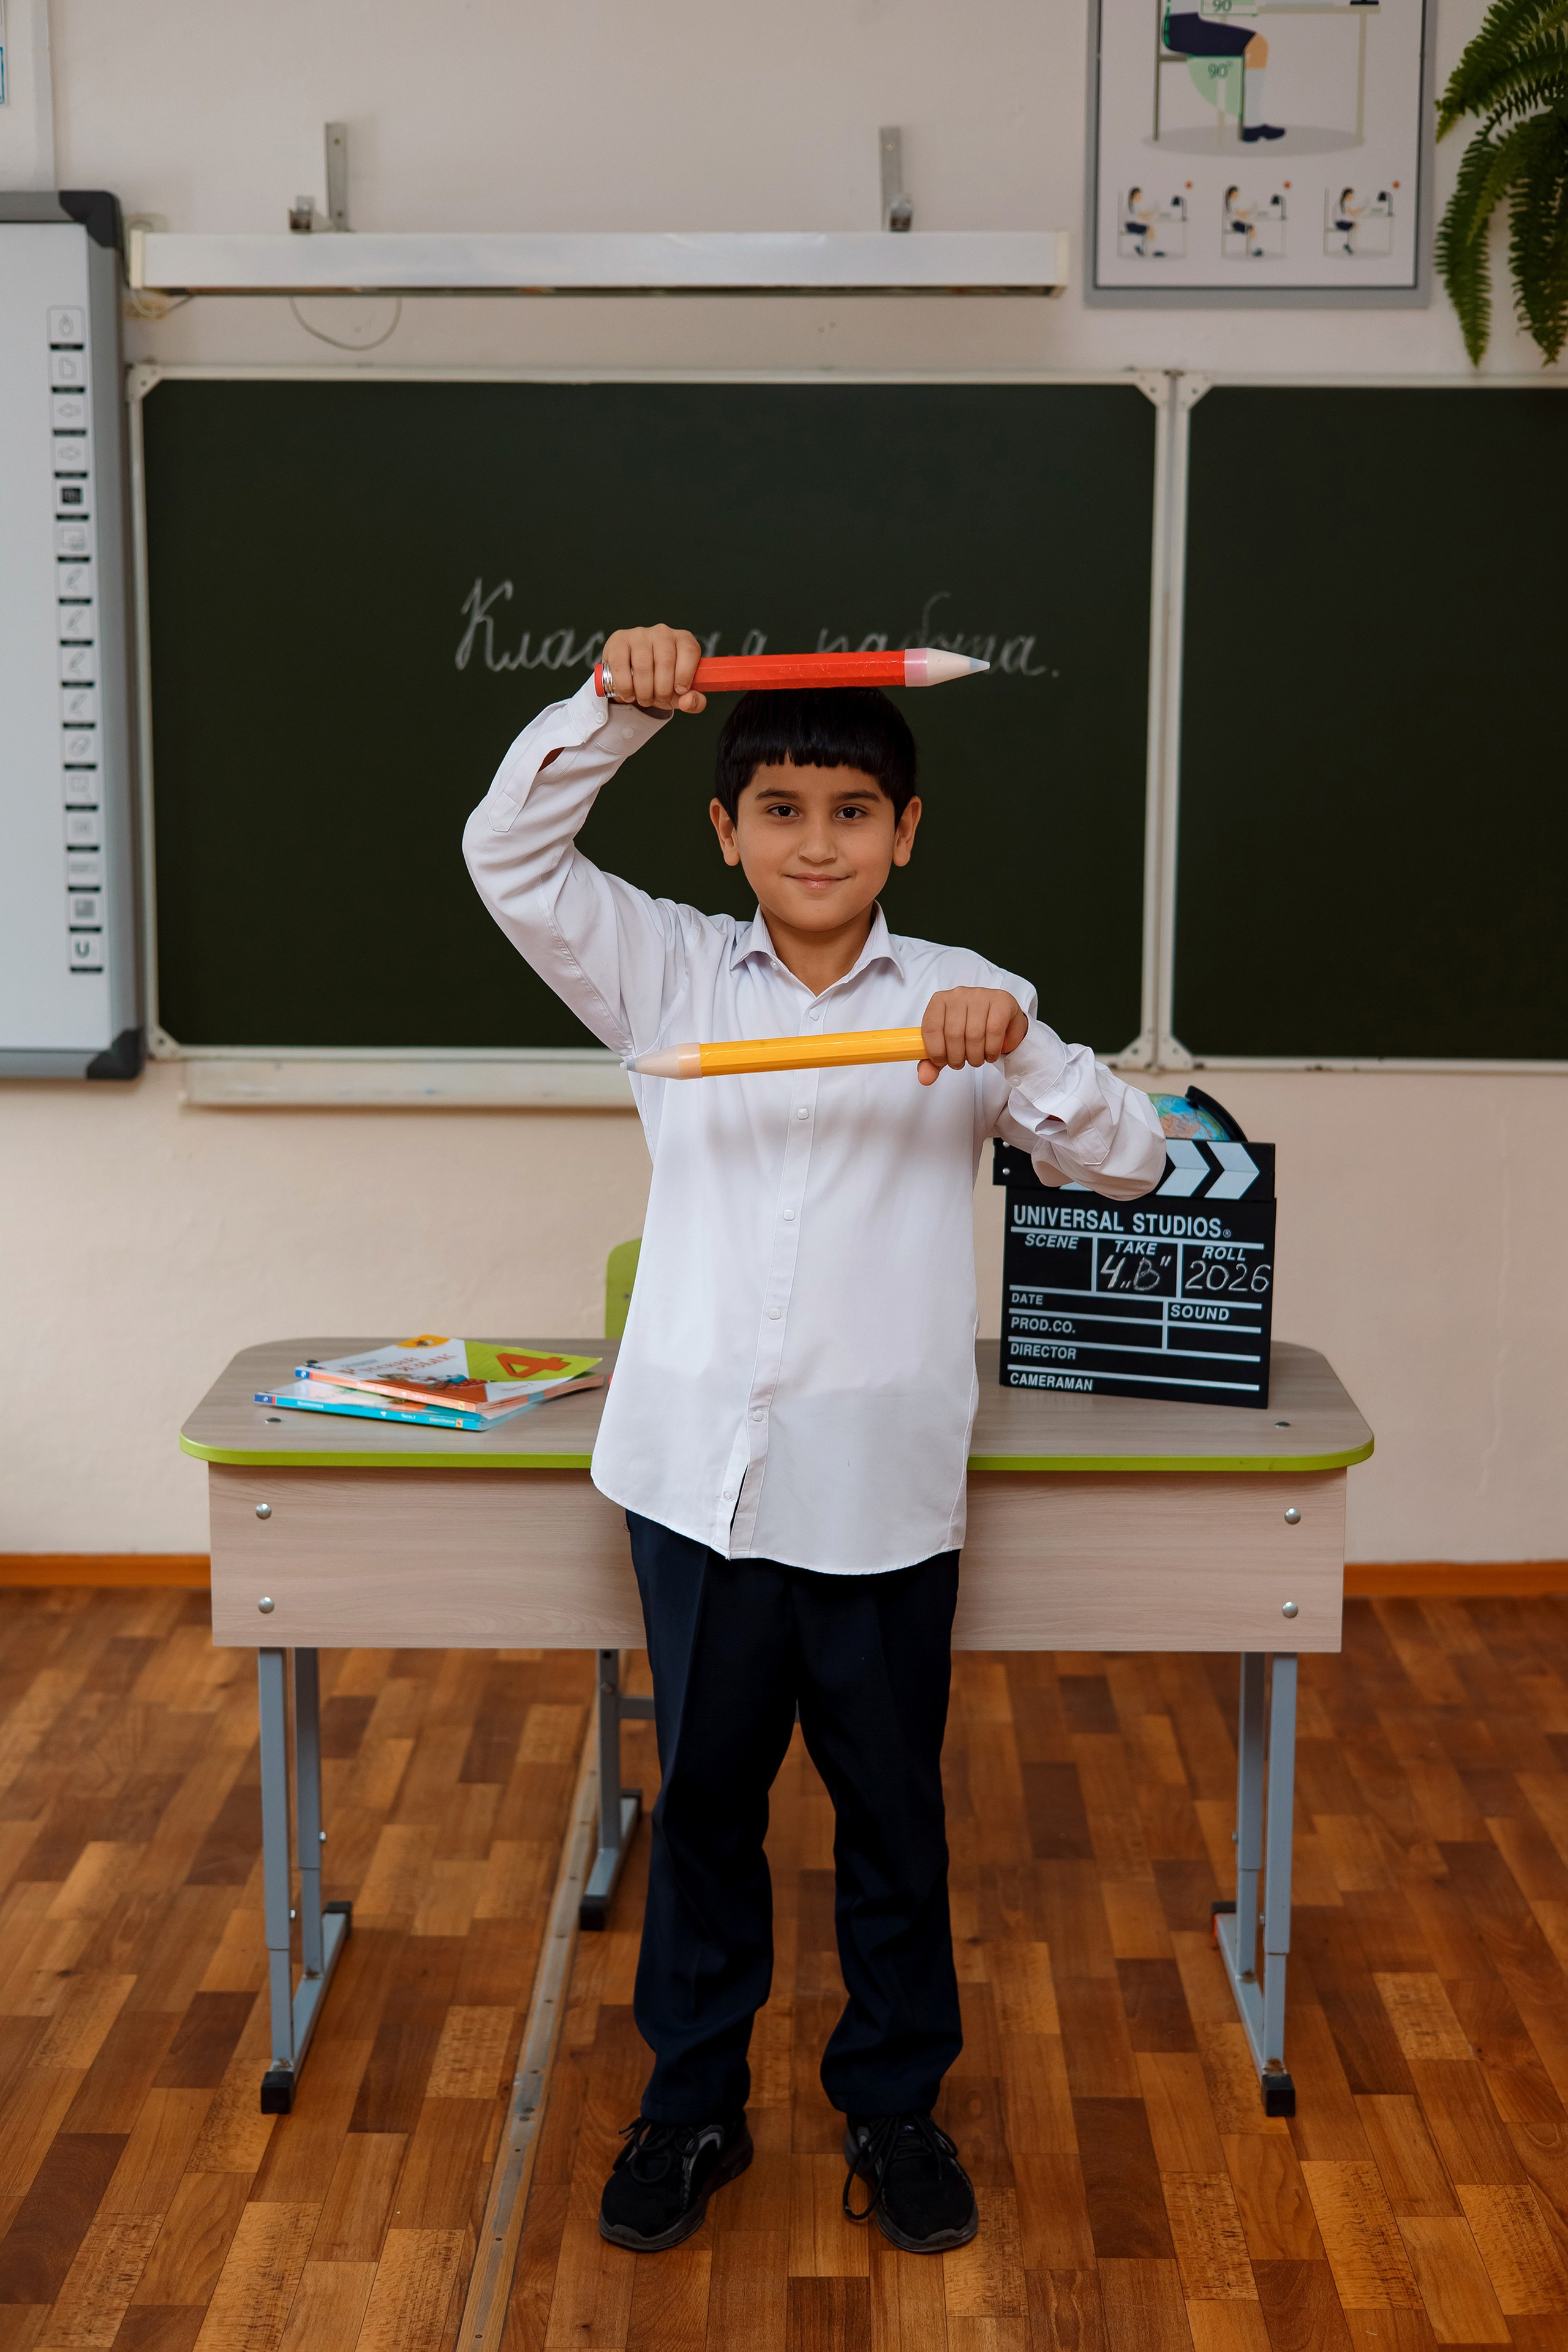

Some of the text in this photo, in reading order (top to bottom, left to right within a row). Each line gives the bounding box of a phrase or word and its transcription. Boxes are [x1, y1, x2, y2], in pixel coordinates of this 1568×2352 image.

[1013, 1204, 1124, 1232] UNIVERSAL
[1024, 1232, 1079, 1250] SCENE
[1114, 1240, 1158, 1256] TAKE
[1202, 1246, 1246, 1262] ROLL
[1185, 1259, 1272, 1292] 2026
[1011, 1292, 1044, 1305] DATE
[1170, 1304, 1230, 1321] SOUND
[1011, 1316, 1076, 1334] PROD.CO.
[1010, 1343, 1077, 1360] DIRECTOR
[496, 1352, 571, 1378] 4
[1010, 1372, 1094, 1391] CAMERAMAN
